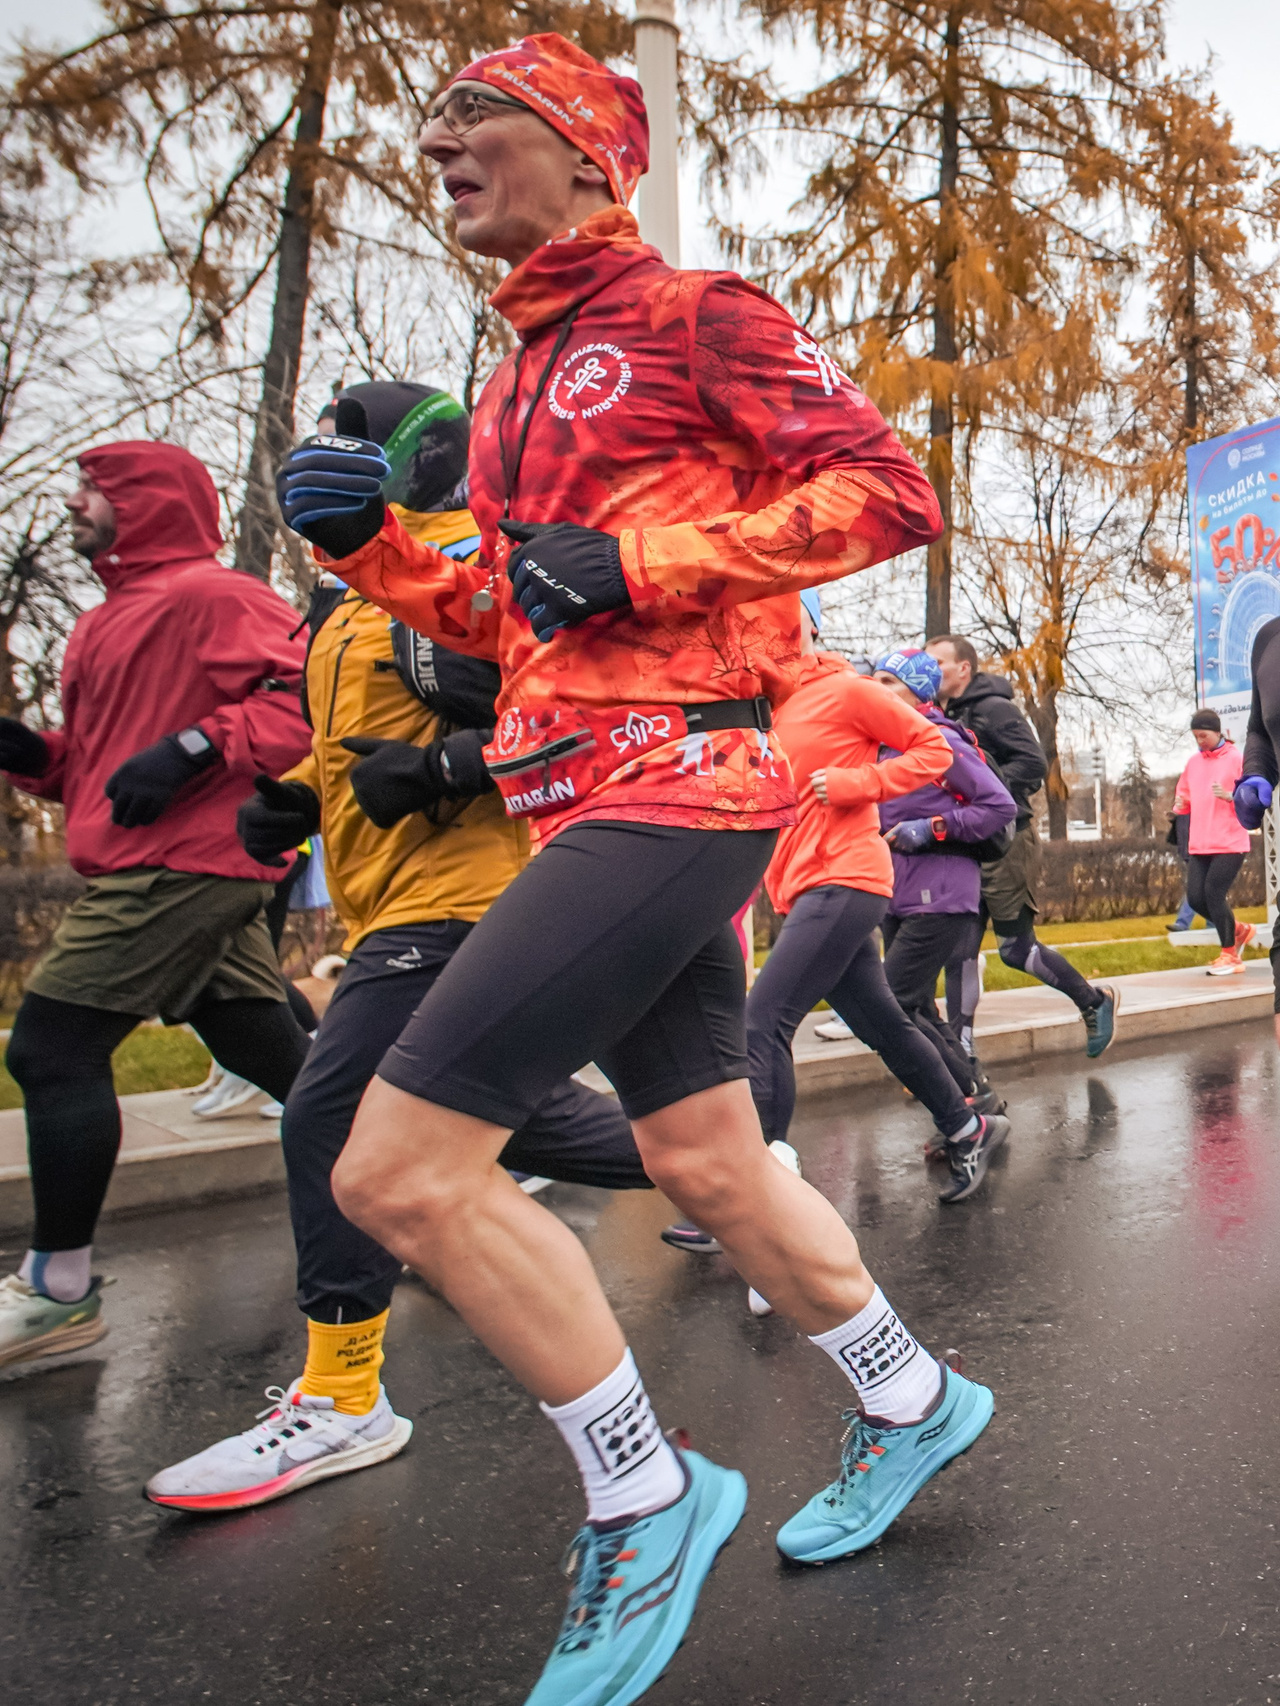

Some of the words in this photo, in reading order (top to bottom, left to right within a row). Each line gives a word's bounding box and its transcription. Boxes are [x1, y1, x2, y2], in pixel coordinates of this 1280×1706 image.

[1208, 471, 1266, 507] СКИДКА
[1212, 508, 1222, 518] на
[1223, 493, 1254, 514] билеты
